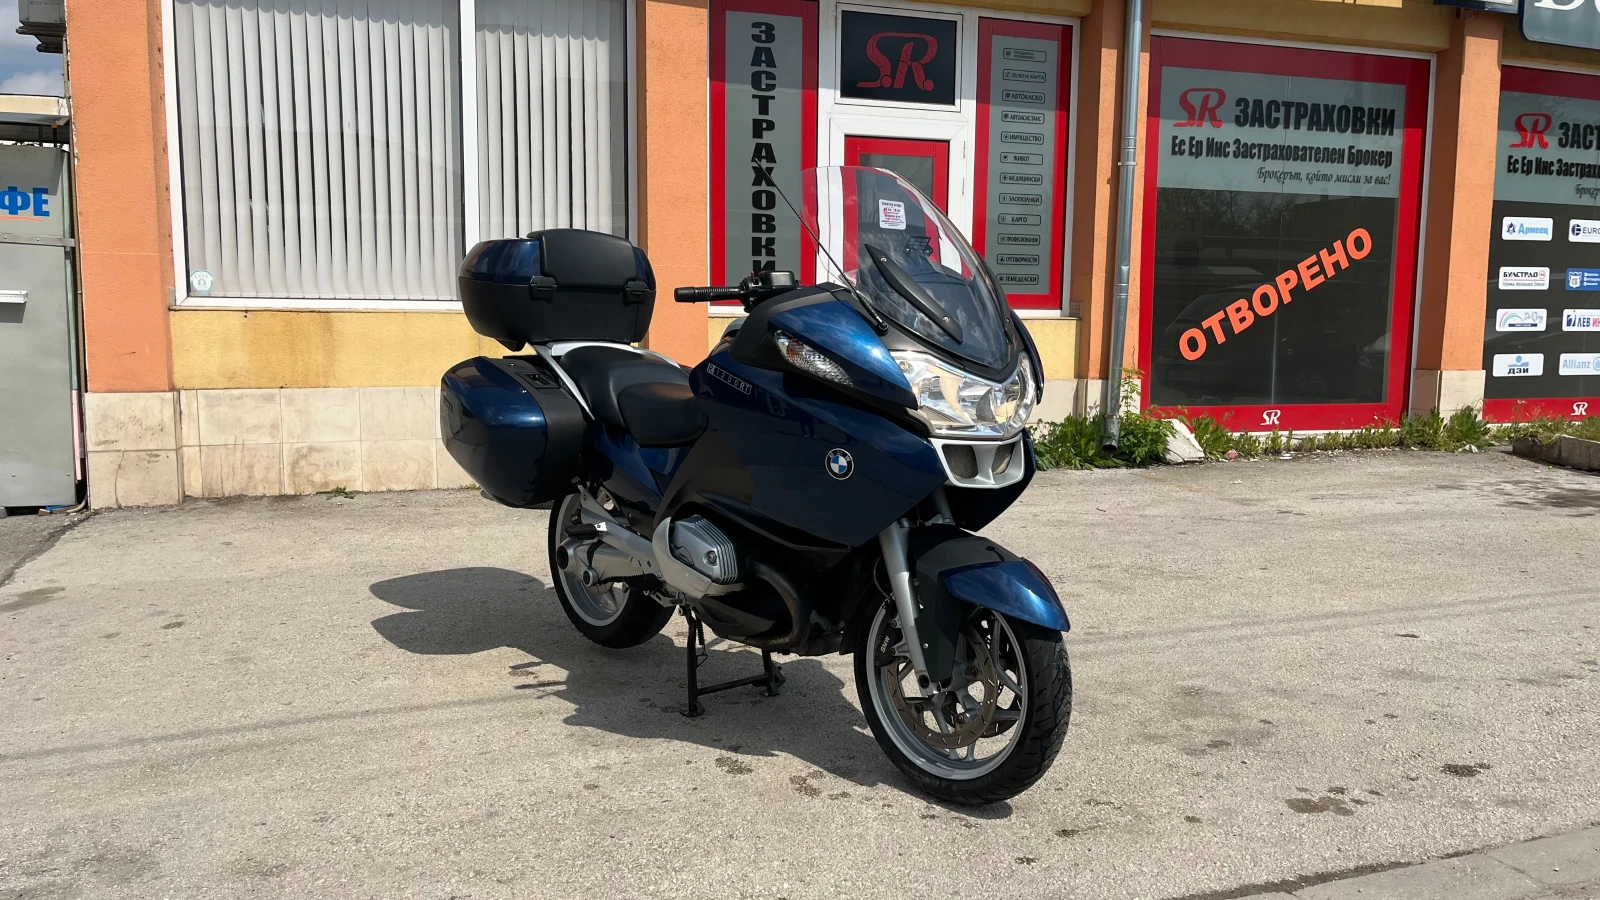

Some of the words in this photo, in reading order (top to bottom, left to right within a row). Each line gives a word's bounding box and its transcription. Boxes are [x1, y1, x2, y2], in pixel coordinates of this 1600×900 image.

[1011, 92, 1043, 101] АВТОКАСКО
[1235, 98, 1395, 136] ЗАСТРАХОВКИ
[1009, 134, 1042, 142] ИМУЩЕСТВО
[750, 21, 777, 271] ЗАСТРАХОВКИ
[1171, 135, 1187, 156] Ес
[1188, 136, 1203, 159] Ер
[1206, 137, 1231, 158] Инс
[1233, 138, 1345, 165] Застрахователен
[1347, 145, 1393, 169] Брокер
[1507, 154, 1519, 174] Ес
[1521, 155, 1533, 176] Ер
[1534, 157, 1555, 176] Инс
[1008, 175, 1041, 183] МЕДИЦИНСКИ
[1306, 171, 1333, 185] който
[1334, 174, 1361, 184] мисли
[1363, 174, 1374, 184] за
[1374, 173, 1392, 185] вас!
[0, 186, 50, 217] ФЕ
[1008, 195, 1040, 203] ЗЛОПОЛУКИ
[1518, 222, 1549, 235] Армеец
[1005, 256, 1038, 264] ОТГОВОРНОСТИ
[1005, 275, 1037, 283] ЗЕМЕДЕЛСКИ
[1179, 228, 1373, 361] ОТВОРЕНО
[1577, 317, 1591, 327] ЛЕВ
[1562, 359, 1591, 370] Allianz
[1507, 367, 1529, 375] ДЗИ
[880, 635, 890, 653] BMW
